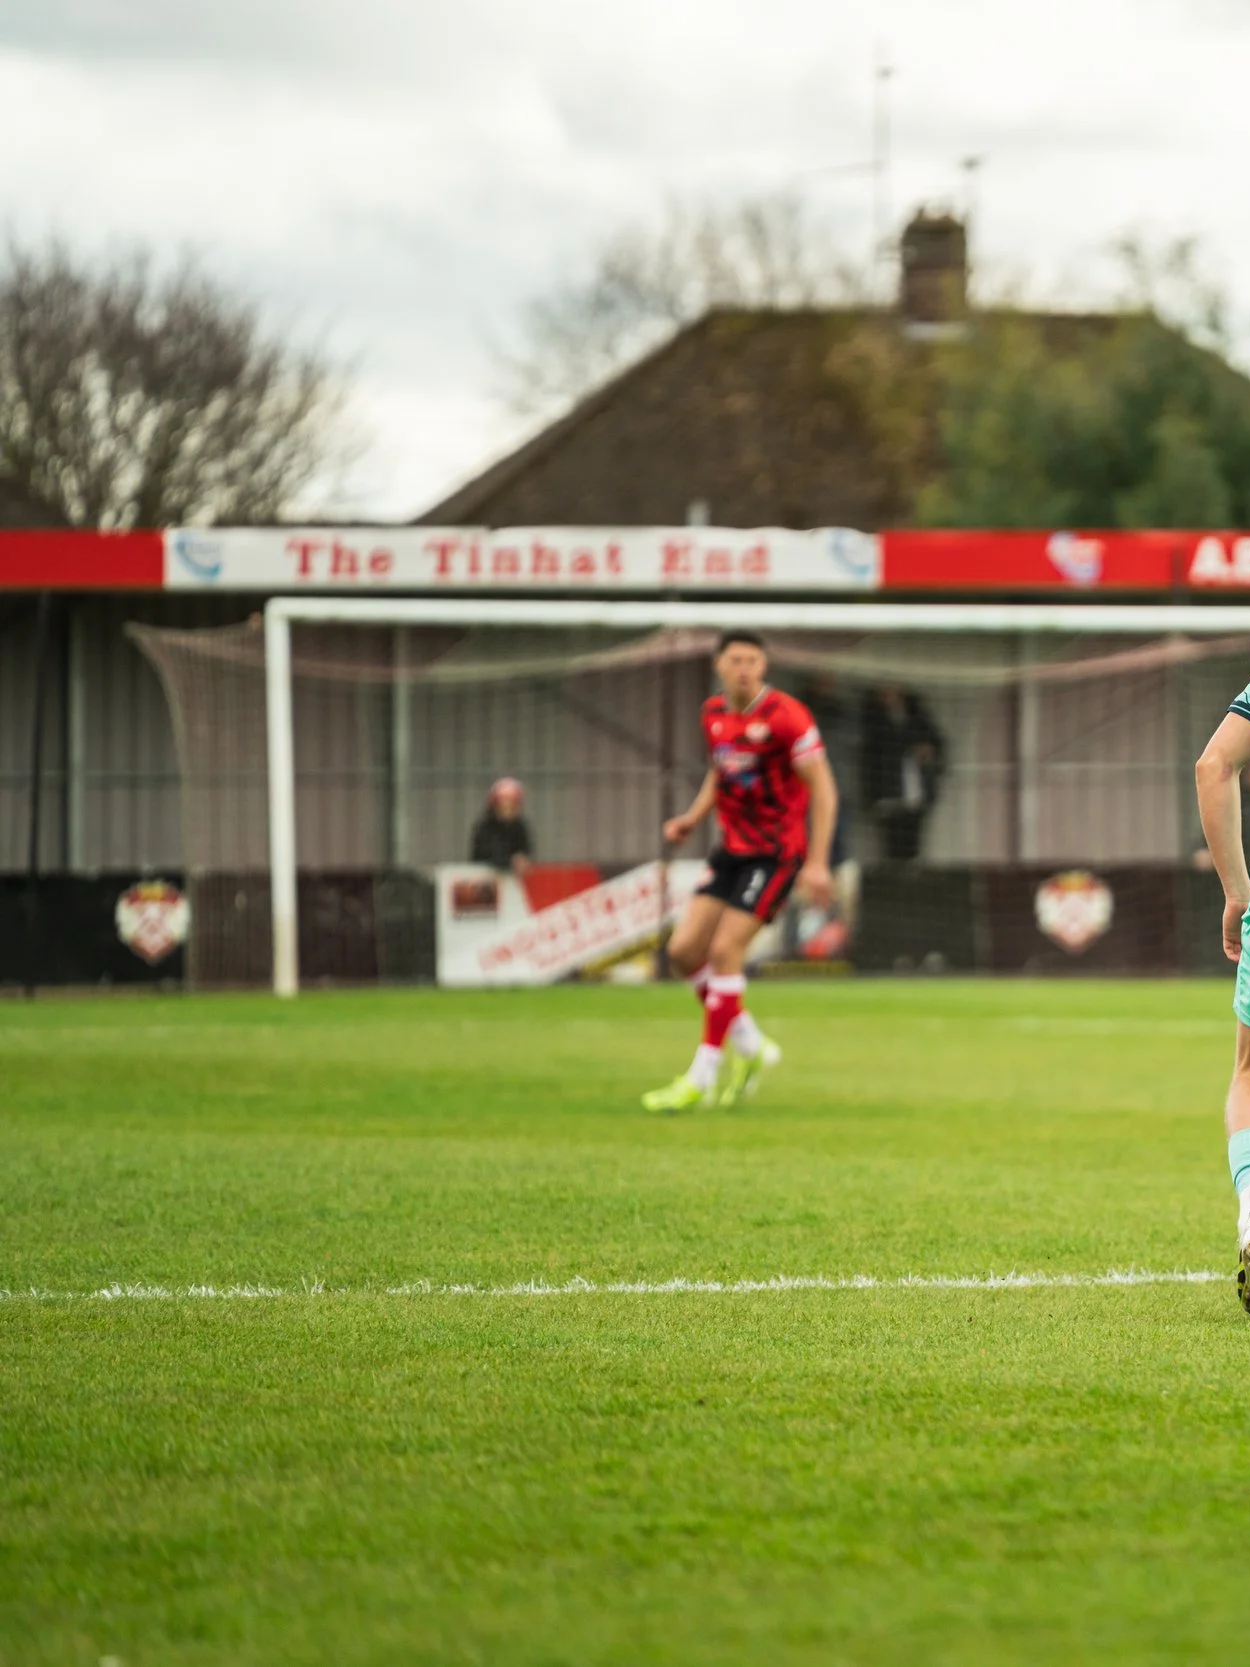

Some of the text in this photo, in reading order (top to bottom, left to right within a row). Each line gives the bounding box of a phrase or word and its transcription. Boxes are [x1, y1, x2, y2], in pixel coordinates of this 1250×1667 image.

[285, 534, 771, 578] The Tinhat End
